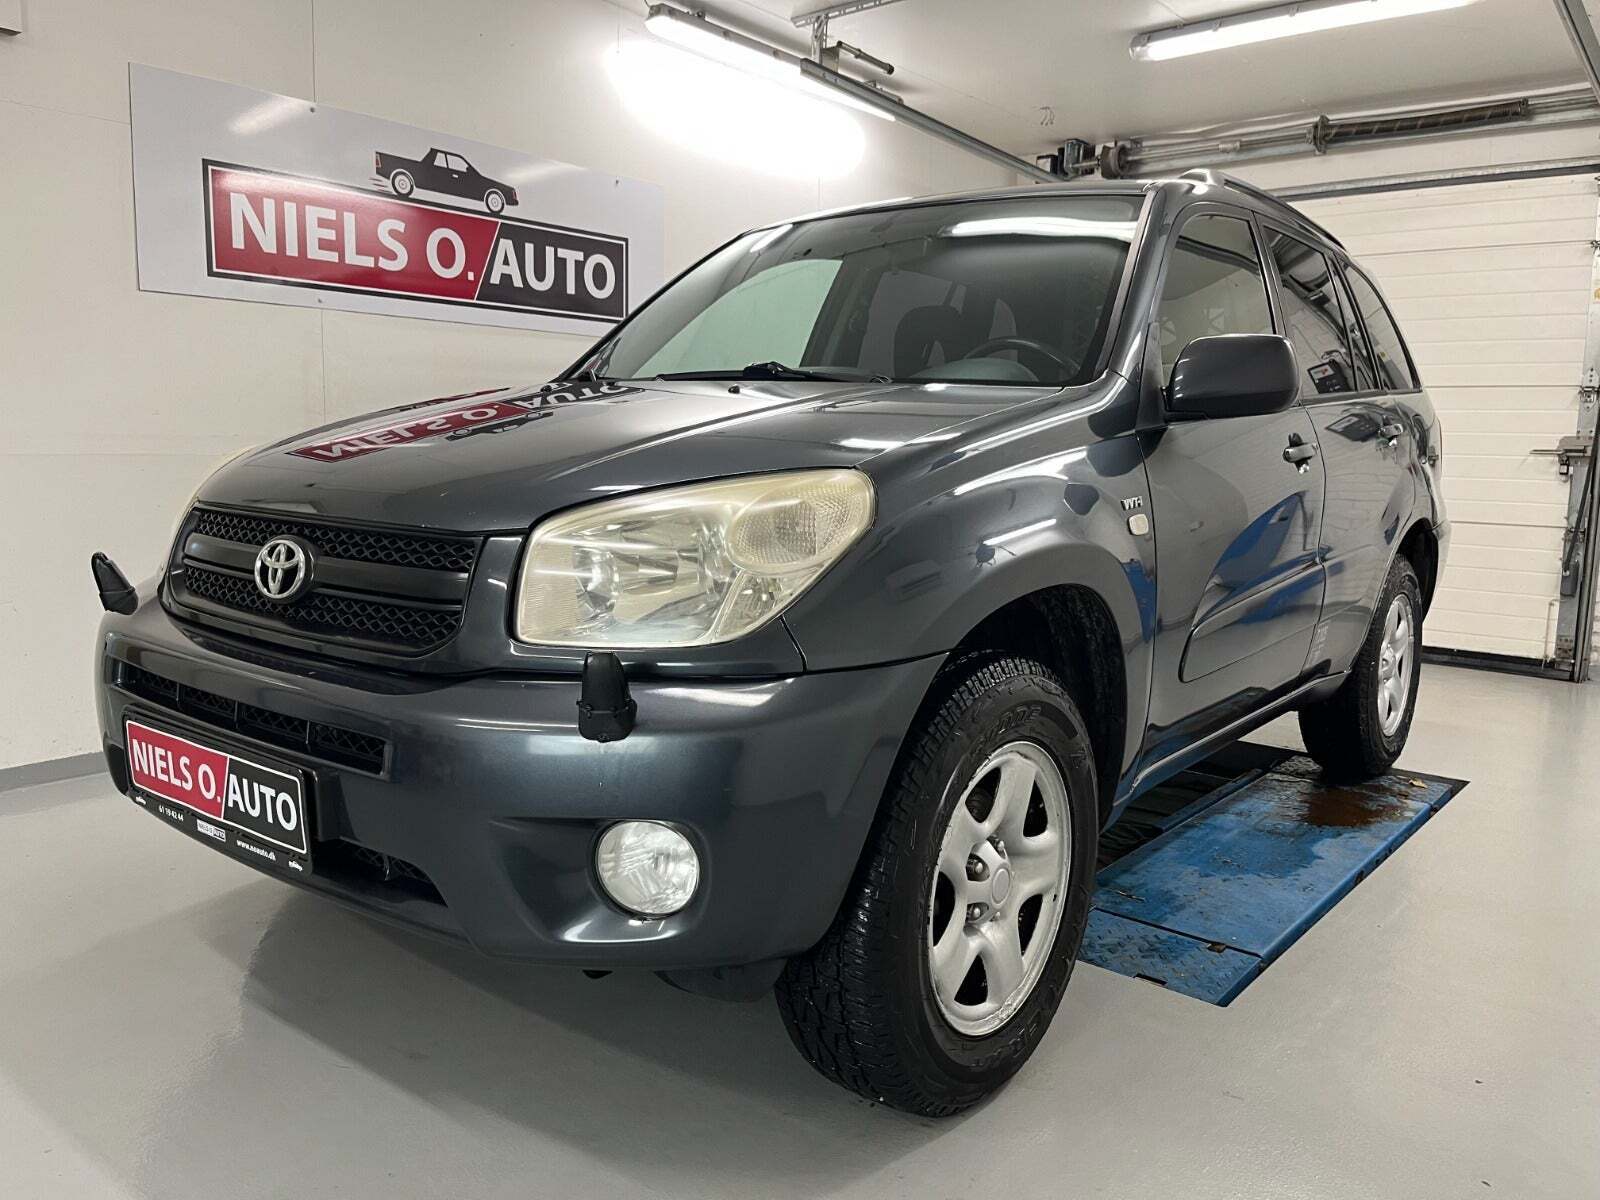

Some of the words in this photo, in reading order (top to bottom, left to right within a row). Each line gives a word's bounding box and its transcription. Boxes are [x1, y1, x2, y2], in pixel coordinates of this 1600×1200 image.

[229, 192, 409, 272] NIELS
[425, 227, 476, 282] O.
[488, 238, 617, 300] AUTO
[132, 738, 193, 792] NIELS
[197, 763, 222, 804] O.
[227, 773, 298, 831] AUTO
